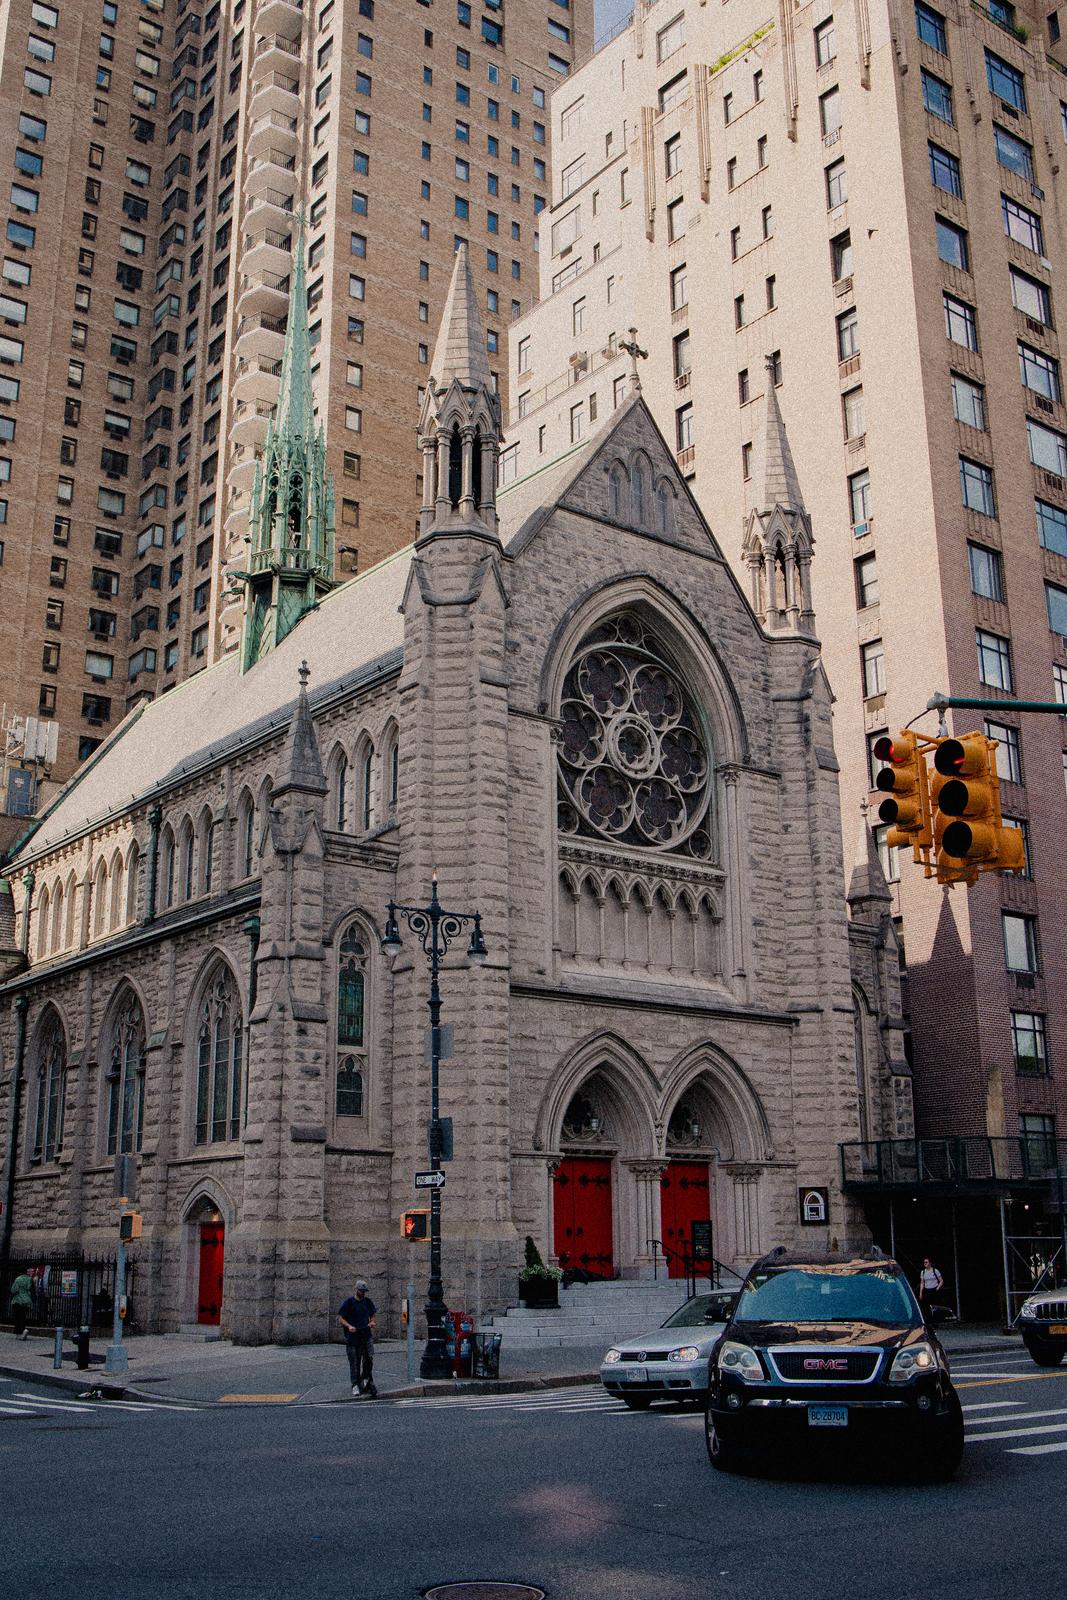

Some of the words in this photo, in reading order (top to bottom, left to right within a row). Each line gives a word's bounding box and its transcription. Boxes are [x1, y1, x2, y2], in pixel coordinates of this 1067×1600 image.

[417, 1176, 427, 1184] ONE
[432, 1175, 442, 1183] WAY
[803, 1358, 849, 1370] GMC
